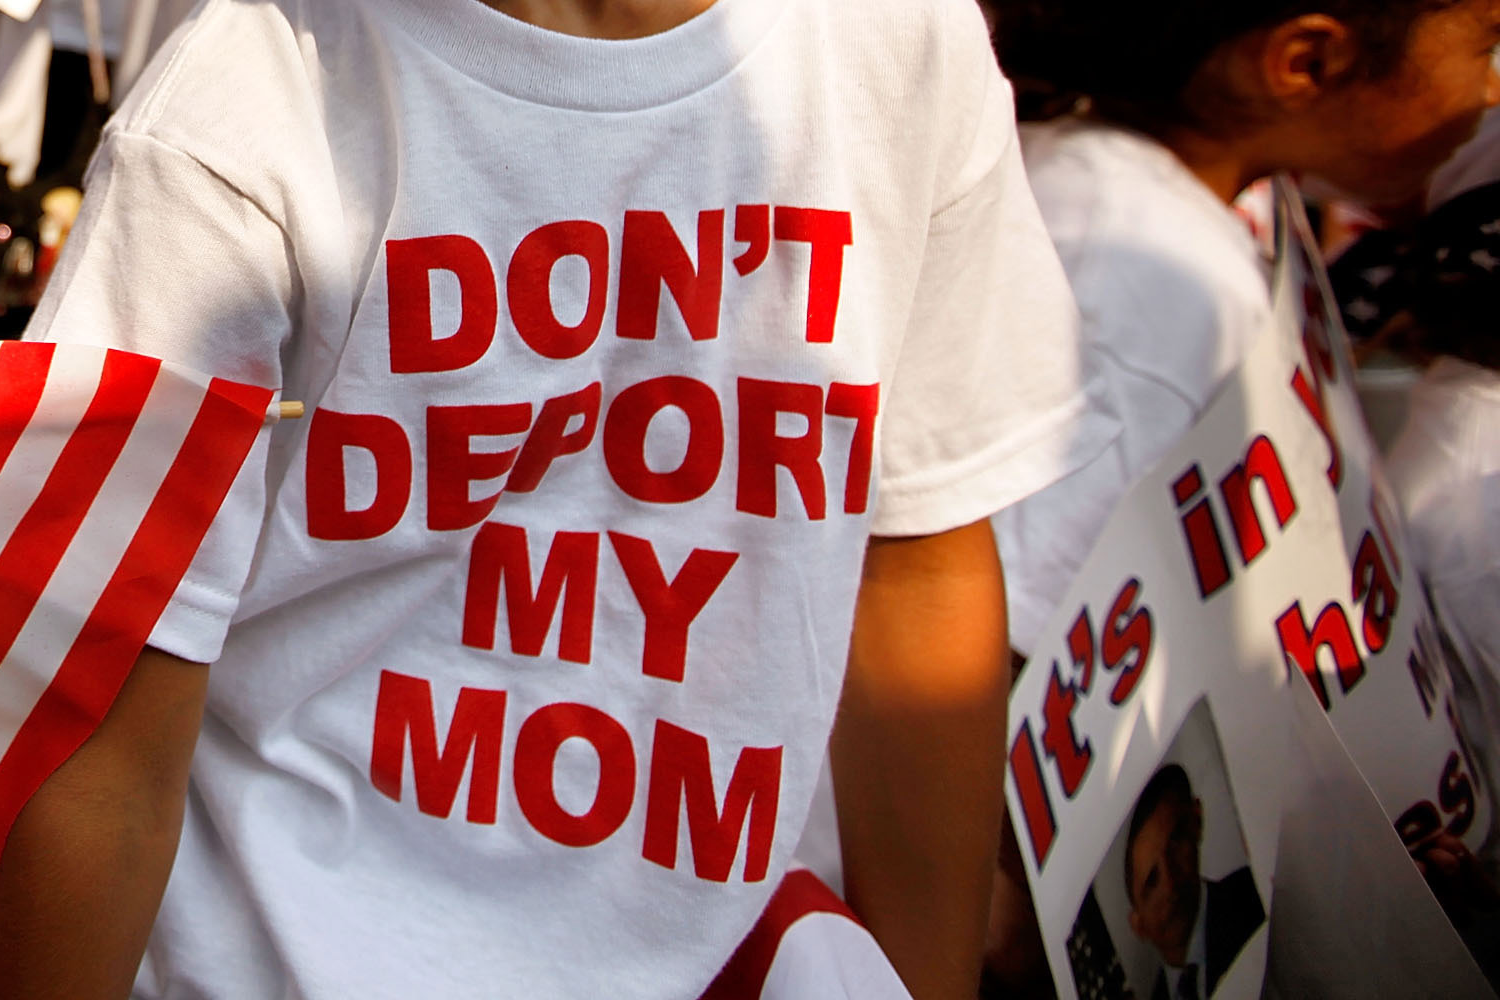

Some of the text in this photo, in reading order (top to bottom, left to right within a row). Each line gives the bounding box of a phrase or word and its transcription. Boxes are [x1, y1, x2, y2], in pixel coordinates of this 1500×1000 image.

[385, 204, 854, 374] DON'T
[305, 375, 881, 542] DEPORT
[461, 521, 741, 684] MY
[1009, 577, 1154, 872] It's
[1171, 434, 1298, 600] in
[370, 669, 784, 884] MOM
